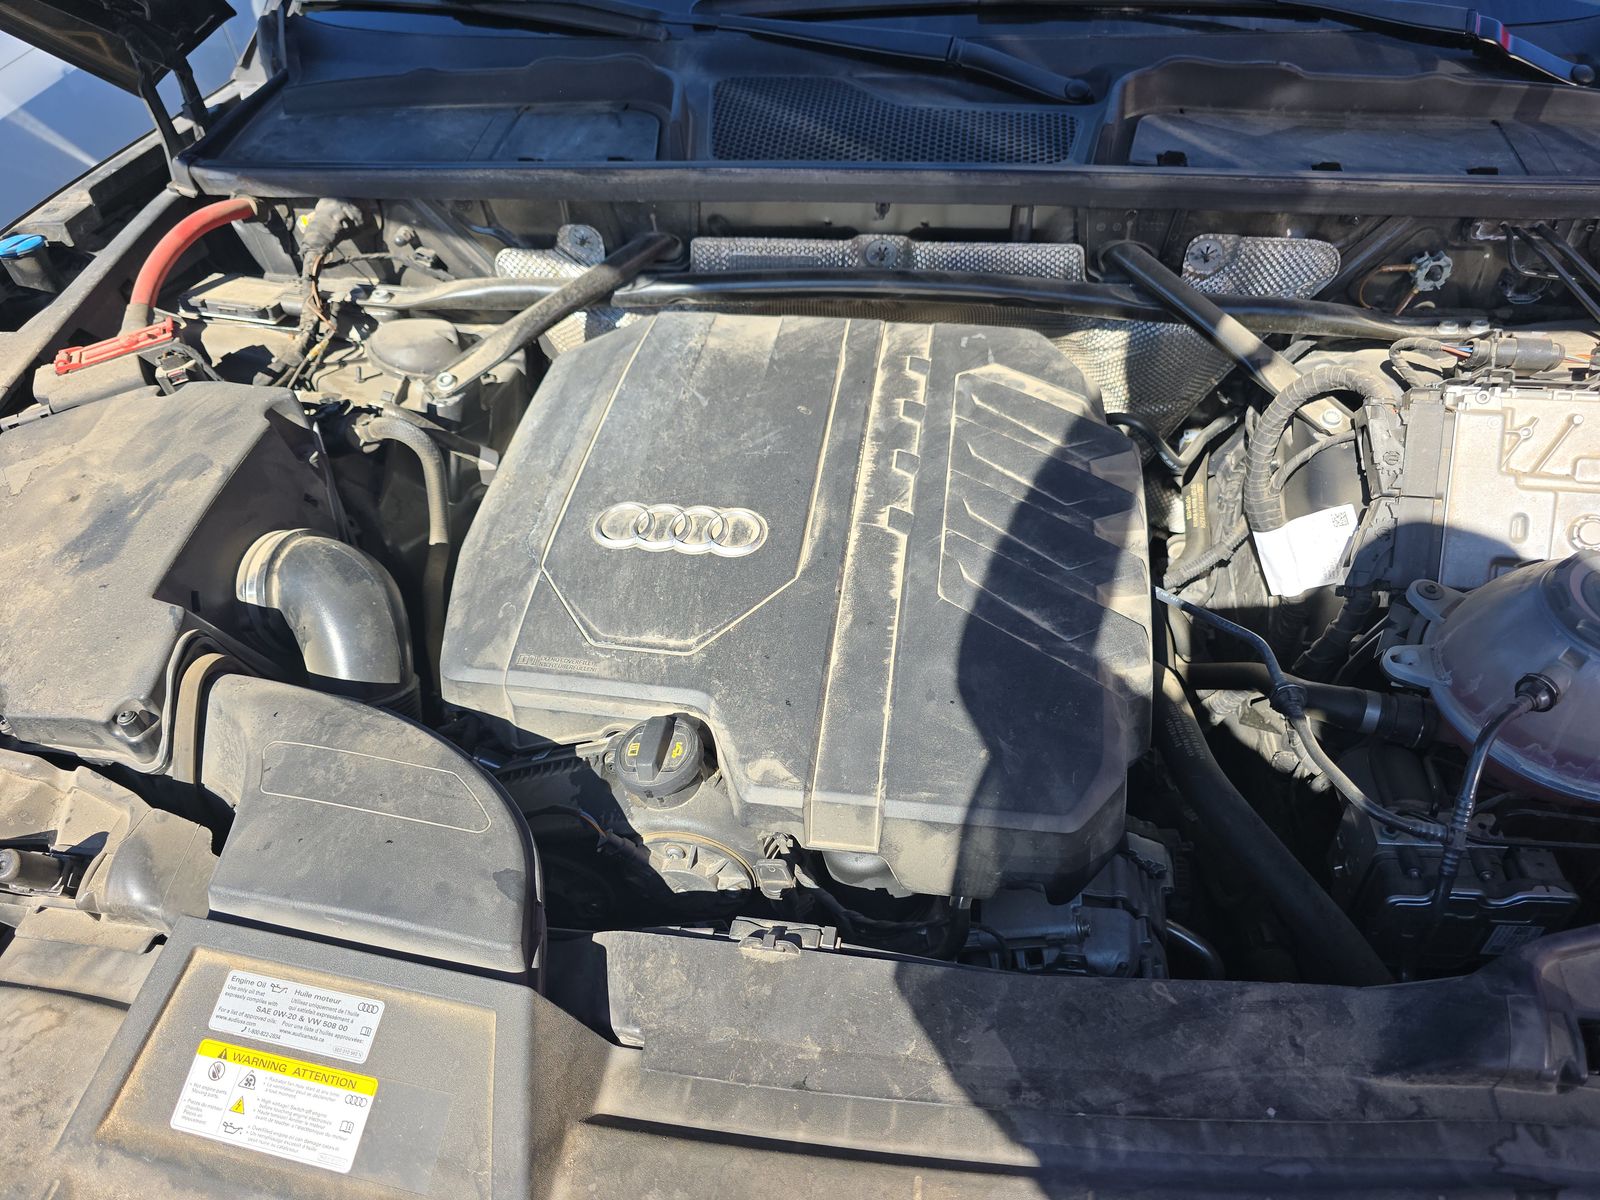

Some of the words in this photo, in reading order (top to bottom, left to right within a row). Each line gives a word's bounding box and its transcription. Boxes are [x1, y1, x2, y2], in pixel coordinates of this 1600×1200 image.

[231, 976, 255, 986] Engine
[295, 990, 312, 998] Huile
[314, 994, 341, 1004] moteur
[290, 998, 308, 1006] Utilisez
[309, 1002, 337, 1012] uniquement
[216, 1015, 256, 1026] www.audiusa.com
[244, 1013, 266, 1021] approved
[256, 1006, 272, 1015] SAE
[273, 1010, 297, 1020] 0W-20
[307, 1017, 321, 1025] VW
[323, 1020, 336, 1029] 508
[279, 1029, 325, 1041] www.audicanada.ca
[315, 1029, 334, 1037] d'huiles
[232, 1054, 287, 1072] WARNING
[292, 1068, 357, 1088] ATTENTION
